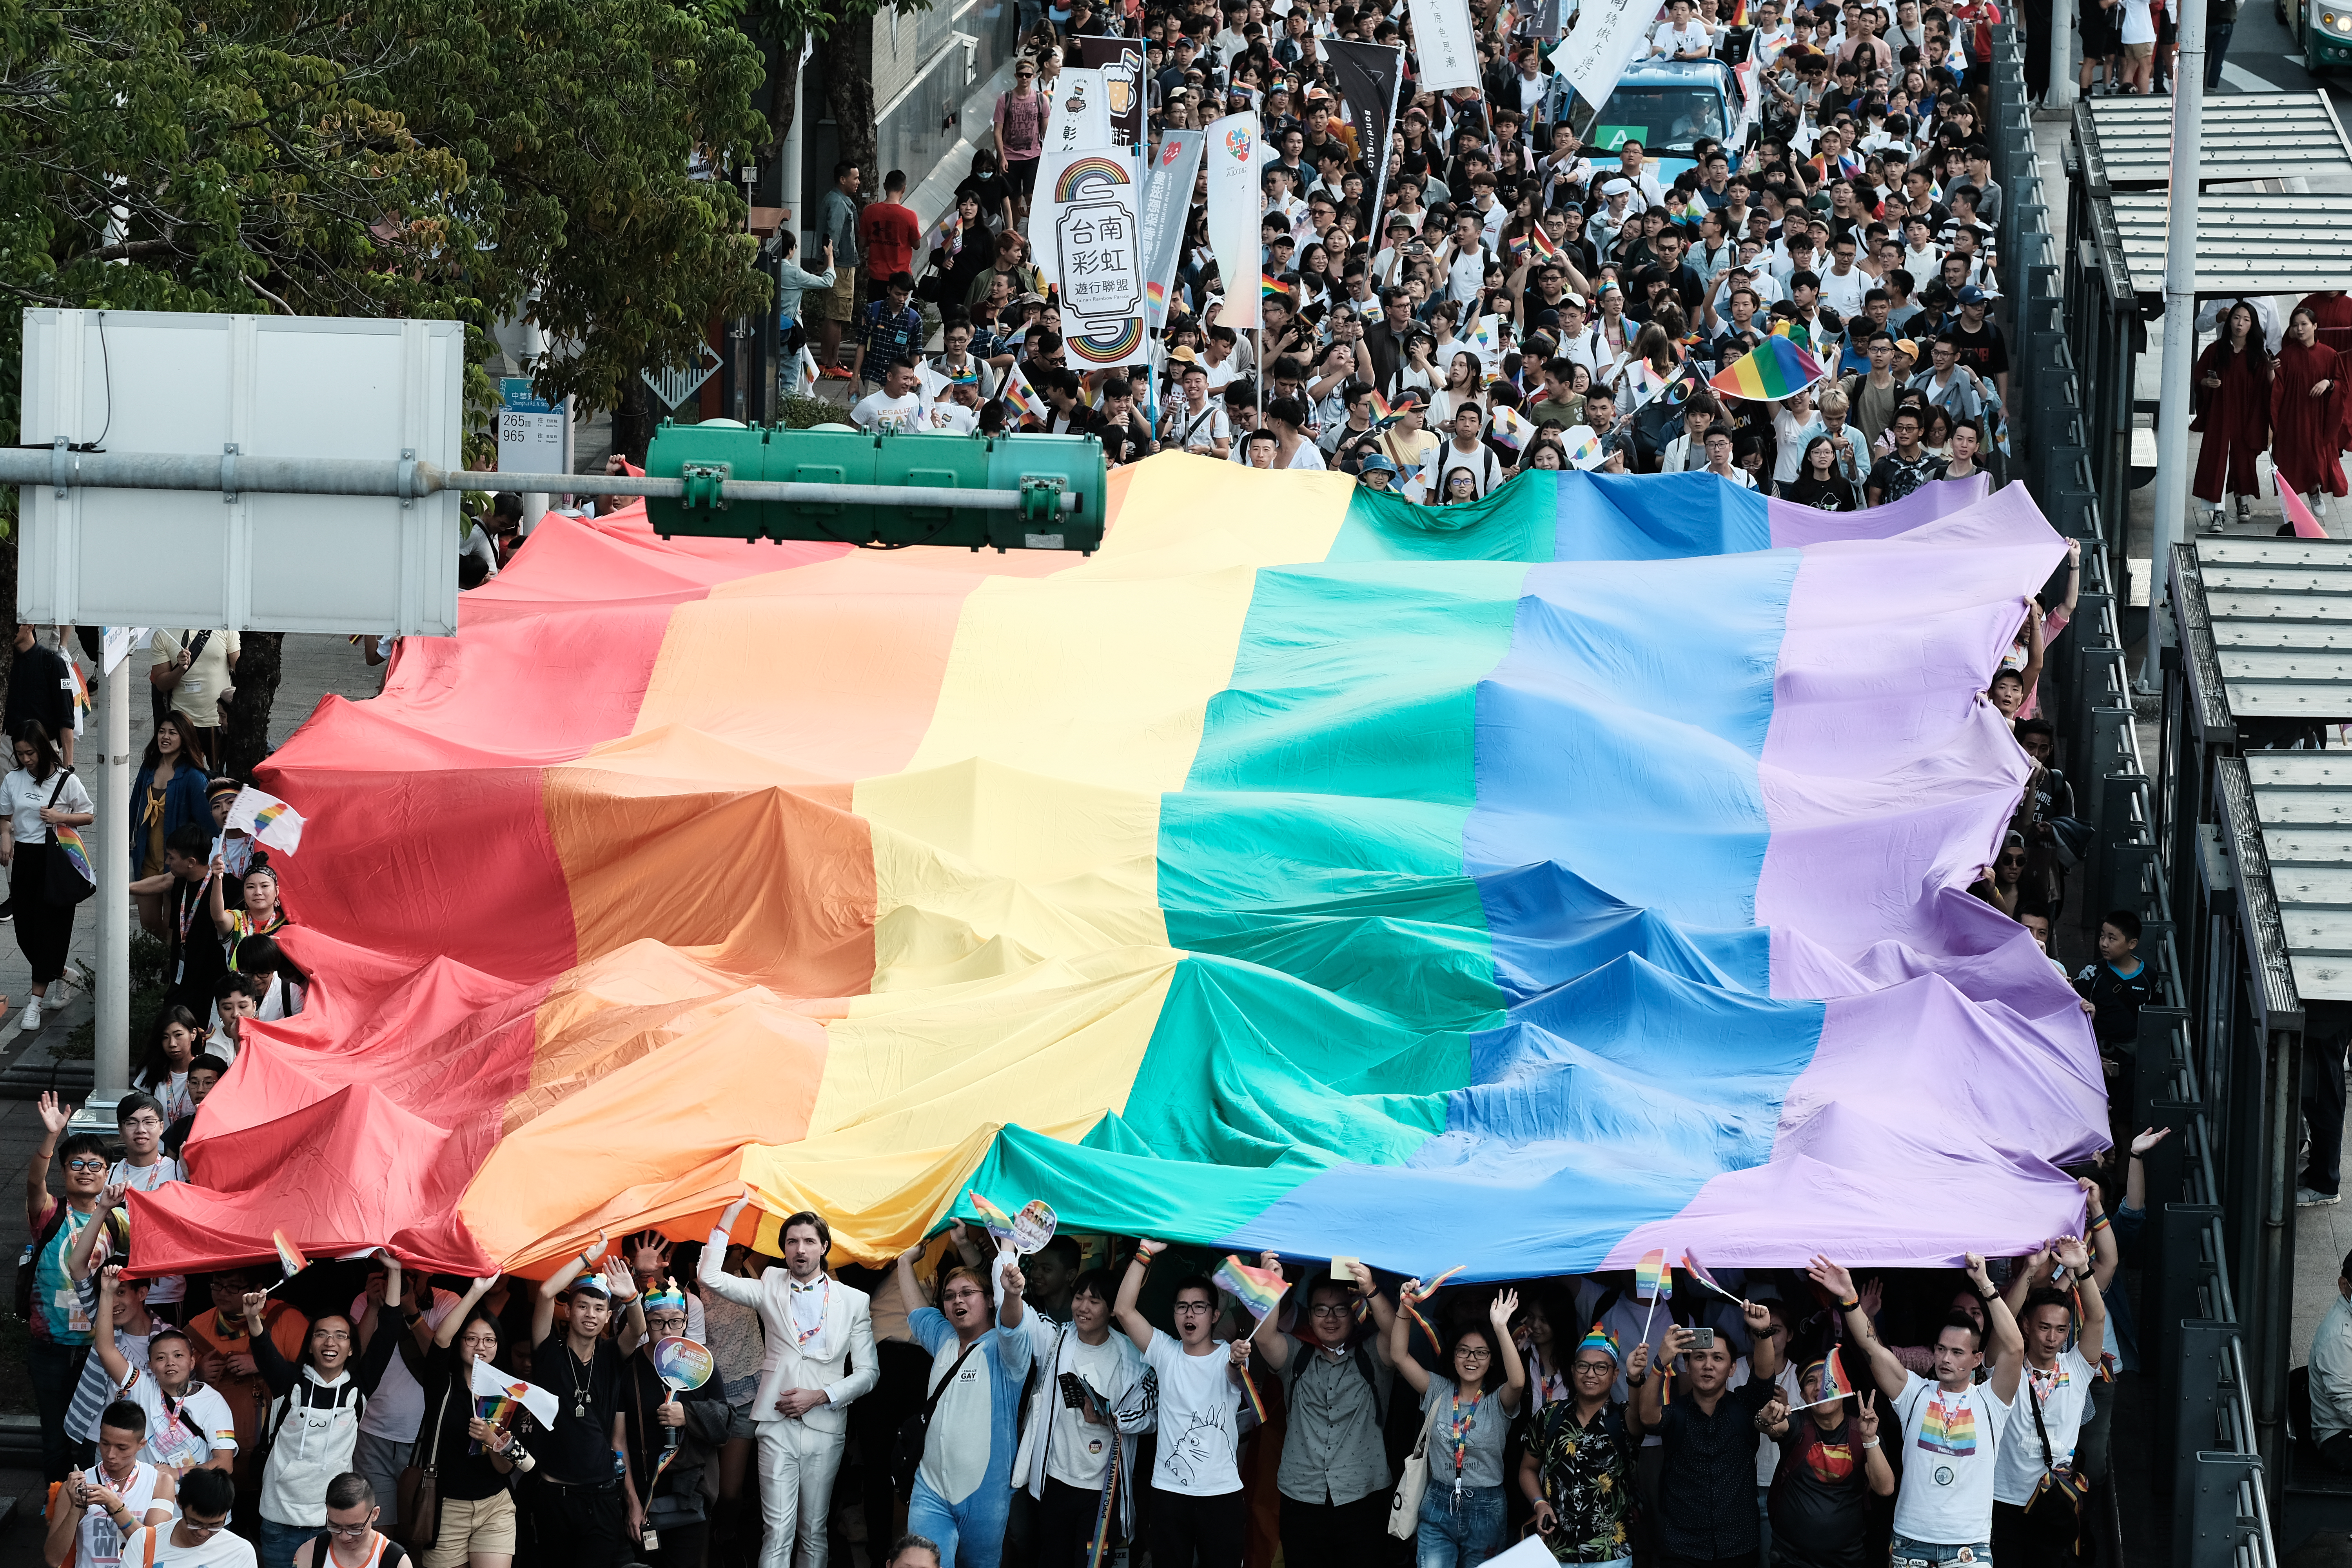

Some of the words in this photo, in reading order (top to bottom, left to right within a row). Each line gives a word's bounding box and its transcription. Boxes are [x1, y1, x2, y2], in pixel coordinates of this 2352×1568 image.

[1012, 113, 1037, 122] UTURE
[1608, 130, 1628, 149] A
[1069, 215, 1122, 244] 台南
[1072, 248, 1127, 275] 彩虹
[1074, 278, 1129, 295] 遊行聯盟
[512, 392, 546, 401] 中華路北
[504, 414, 524, 427] 265
[503, 430, 524, 442] 965
